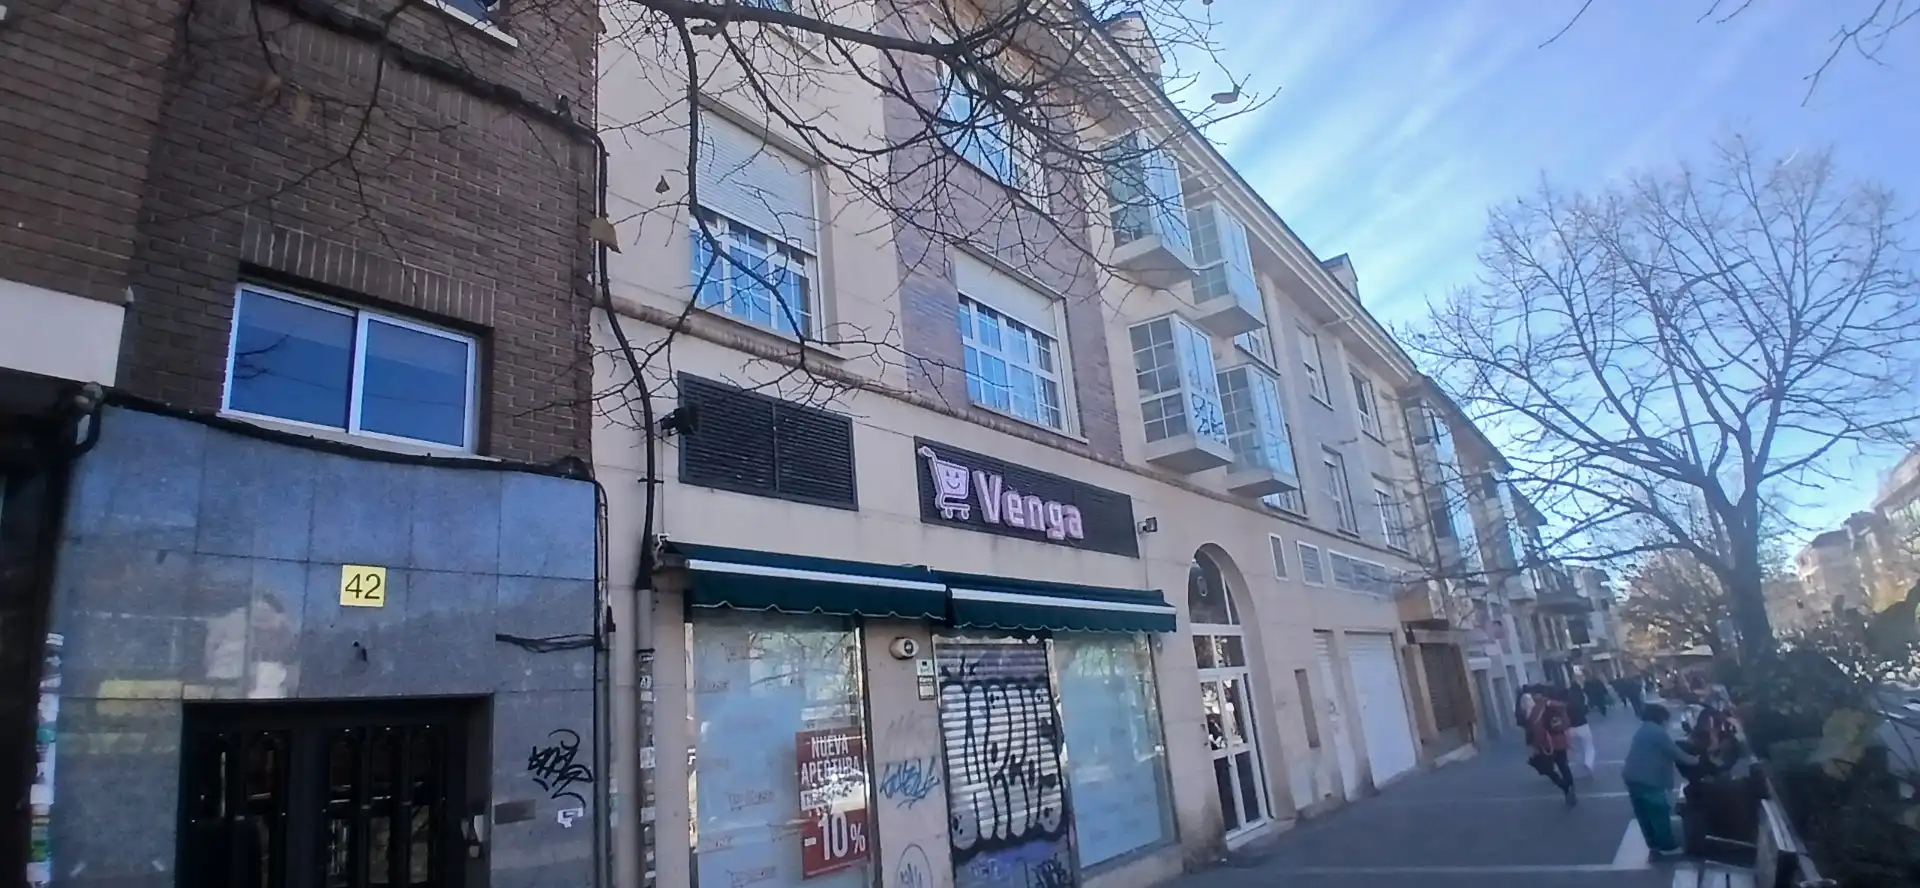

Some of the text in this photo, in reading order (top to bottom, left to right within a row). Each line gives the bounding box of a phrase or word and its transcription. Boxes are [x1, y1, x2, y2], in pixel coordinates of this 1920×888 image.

[973, 470, 1084, 540] Venga
[345, 573, 381, 599] 42
[811, 733, 849, 760] NUEVA
